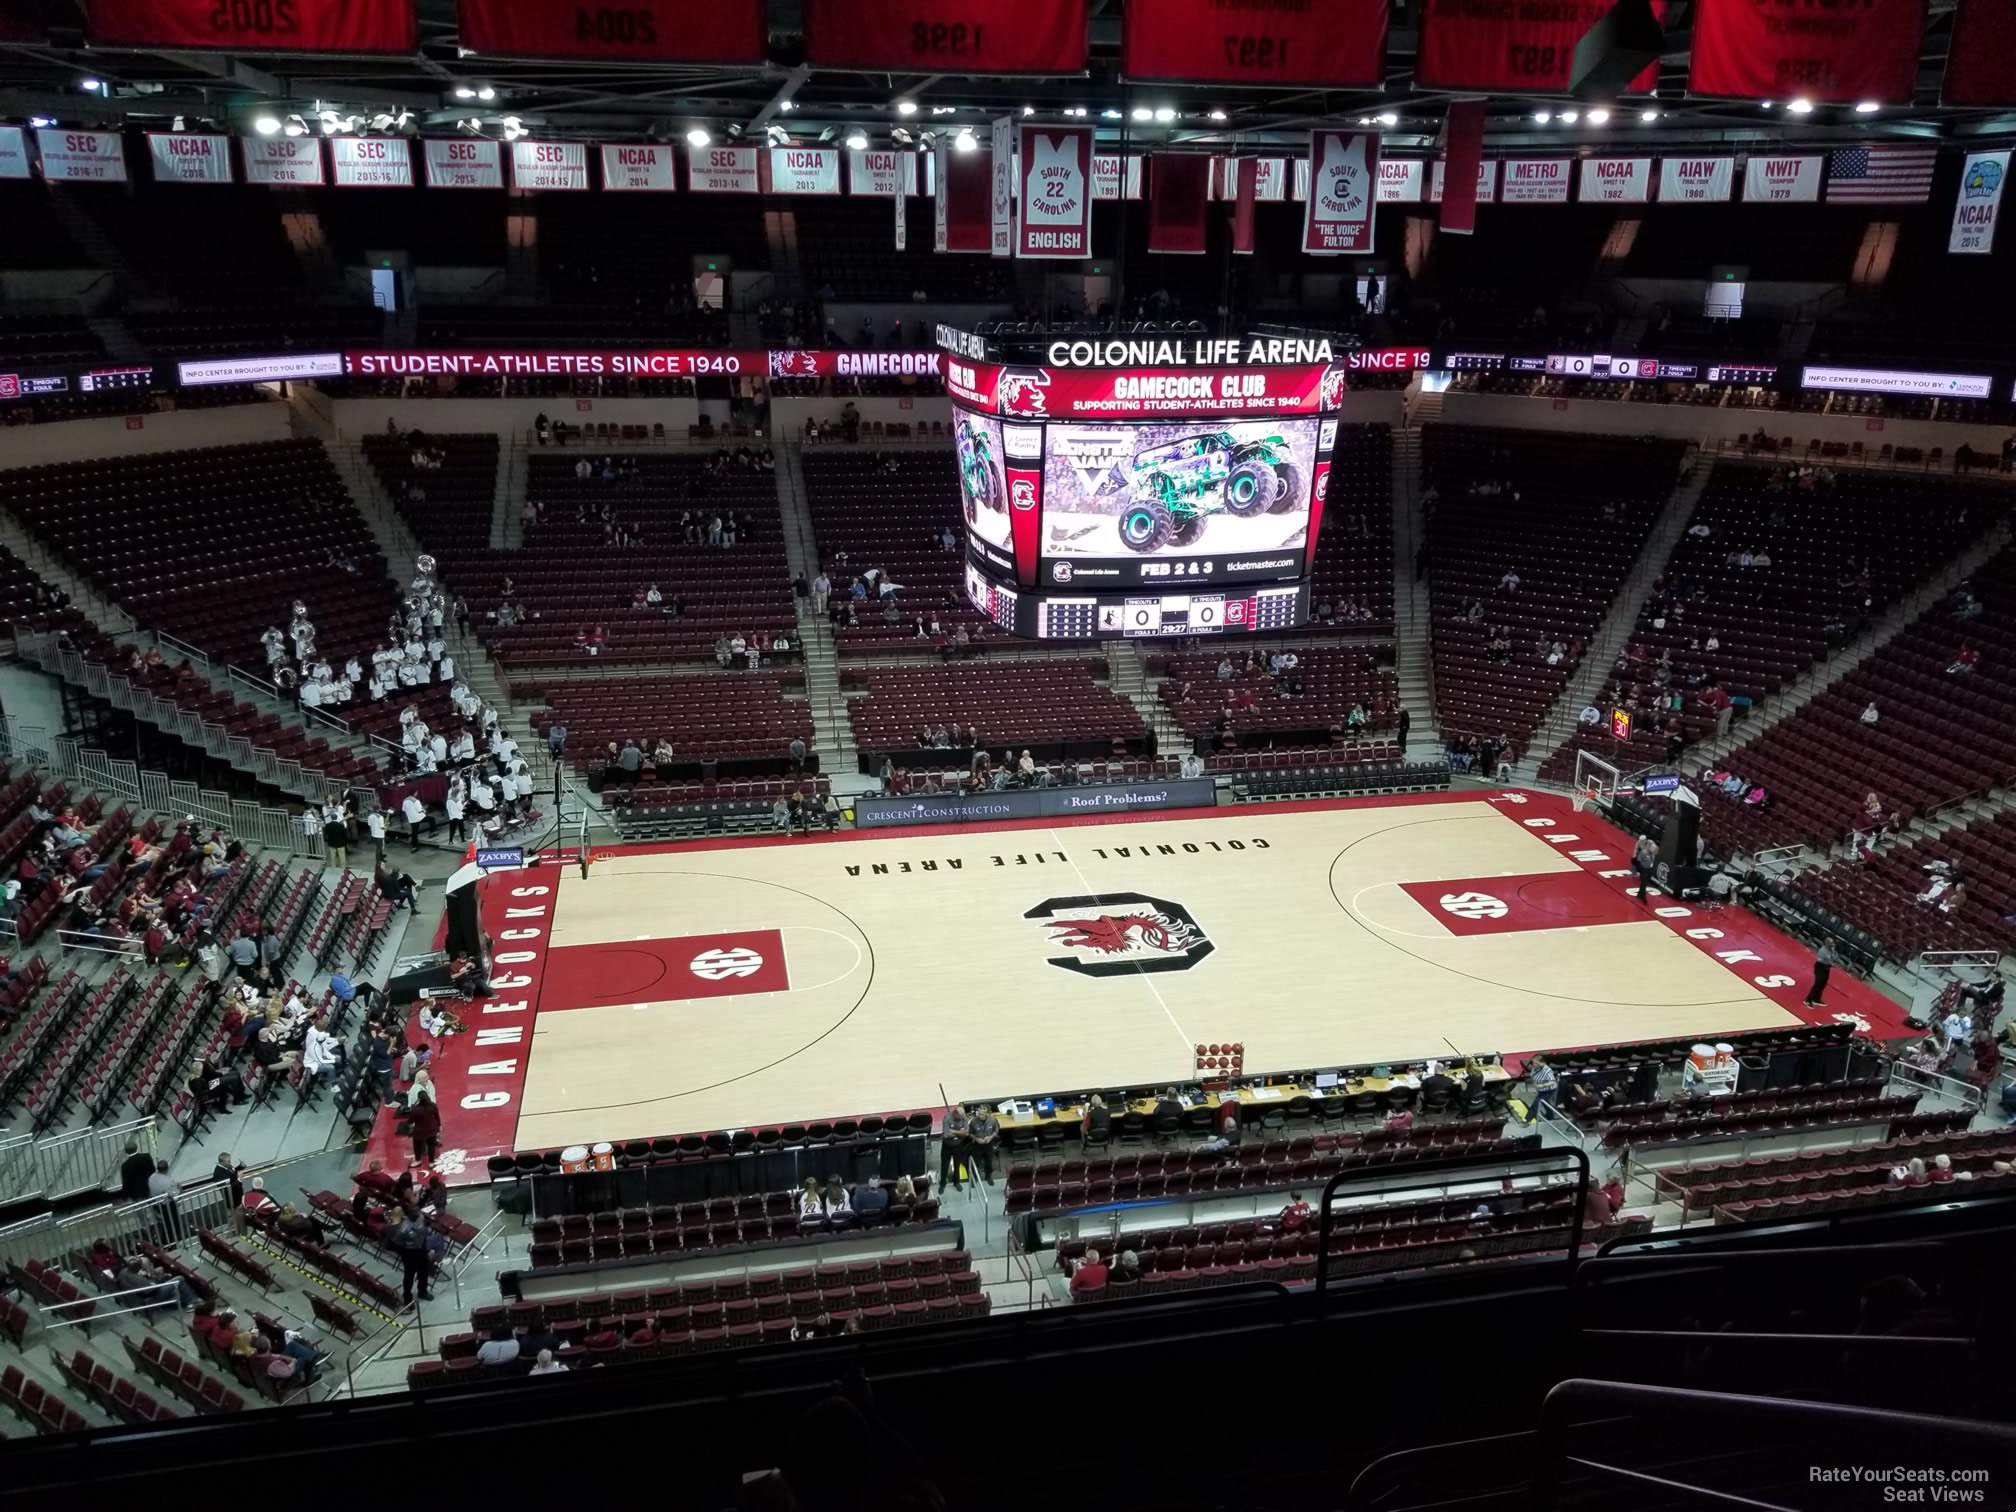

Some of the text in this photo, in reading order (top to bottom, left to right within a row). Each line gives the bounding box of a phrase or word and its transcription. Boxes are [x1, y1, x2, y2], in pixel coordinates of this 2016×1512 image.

[65, 135, 97, 152] SEC
[168, 138, 212, 156] NCAA
[267, 142, 296, 157] SEC
[357, 142, 385, 158] SEC
[448, 143, 477, 160] SEC
[536, 146, 564, 162] SEC
[618, 148, 657, 165] NCAA
[710, 151, 736, 167] SEC
[787, 152, 823, 168] NCAA
[273, 170, 296, 180] 2016
[357, 172, 391, 181] 2015-16
[1040, 166, 1072, 181] SOUTH
[1329, 165, 1359, 178] SOUTH
[1379, 164, 1409, 179] NCAA
[1516, 163, 1559, 179] METRO
[1597, 162, 1633, 178] NCAA
[1678, 161, 1716, 178] AIAW
[1765, 160, 1802, 177] NWIT
[535, 176, 569, 186] 2014-15
[629, 177, 649, 187] 2014
[708, 178, 740, 188] 2013-14
[796, 181, 816, 190] 2013
[874, 183, 894, 192] 2012
[1046, 182, 1065, 198] 22
[1101, 186, 1118, 196] 1991
[1383, 189, 1401, 199] 1986
[1603, 190, 1623, 199] 1982
[1684, 189, 1704, 198] 1980
[1770, 189, 1791, 199] 1979
[1032, 197, 1077, 216] CAROLINA
[1321, 195, 1363, 213] CAROLINA
[1958, 205, 1993, 225] NCAA
[1315, 224, 1365, 236] "THE VOICE"
[1028, 232, 1081, 249] ENGLISH
[1323, 236, 1355, 248] FULTON
[1961, 237, 1980, 247] 2015
[936, 324, 959, 353] COLONIAL
[967, 334, 985, 362] ARENA
[1049, 338, 1335, 367] COLONIAL LIFE ARENA
[1349, 352, 1401, 369] SINCE
[185, 369, 203, 378] INFO
[205, 368, 233, 377] CENTER
[234, 366, 267, 375] BROUGHT
[280, 364, 294, 372] YOU
[361, 355, 604, 374] STUDENT-ATHLETES
[612, 355, 681, 374] SINCE
[686, 355, 740, 374] 1940
[837, 353, 941, 376] GAMECOCK
[1573, 359, 1585, 372] 0
[1618, 361, 1630, 374] 0
[1114, 374, 1266, 400] GAMECOCK CLUB
[1829, 376, 1859, 384] CENTER
[1860, 378, 1898, 386] BROUGHT
[1912, 380, 1930, 388] YOU
[1931, 381, 1945, 389] BY:
[1073, 396, 1301, 411] SUPPORTING STUDENT-ATHLETES SINCE 1940
[1140, 561, 1214, 576] FEB 2 & 3
[1226, 559, 1295, 572] ticketmaster.com
[1135, 609, 1149, 626] 0
[1201, 607, 1214, 623] 0
[1161, 624, 1187, 634] 29:27
[1615, 720, 1627, 737] 30
[1646, 778, 1679, 789] ZAXBY'S
[1071, 790, 1168, 808] Roof Problems?
[866, 804, 1011, 822] CRESCENT CONSTRUCTION
[478, 852, 521, 863] ZAXBY'S
[844, 838, 1272, 878] COLONIAL LIFE ARENA
[1439, 891, 1509, 920] SEC
[1522, 817, 1796, 989] GAMECOCKS
[689, 946, 764, 981] SEC
[459, 885, 550, 1110] GAMECOCKS
